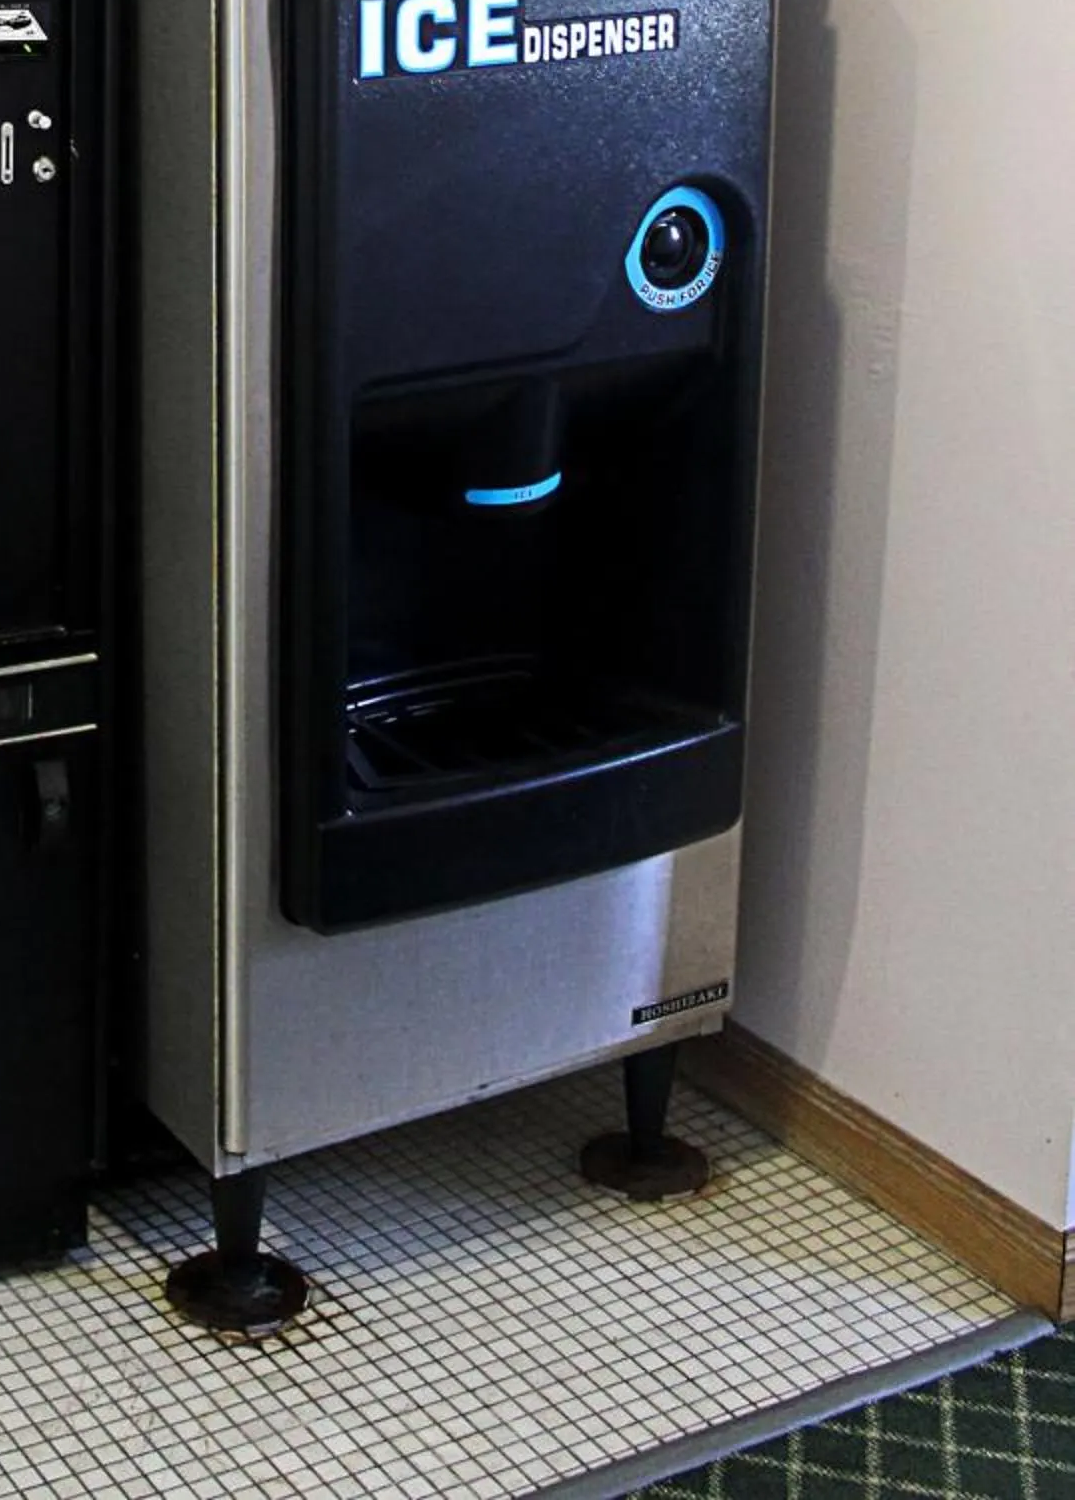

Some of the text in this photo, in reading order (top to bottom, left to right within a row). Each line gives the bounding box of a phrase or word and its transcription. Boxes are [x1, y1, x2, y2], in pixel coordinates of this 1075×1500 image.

[524, 13, 675, 63] DISPENSER
[640, 283, 675, 306] PUSH
[680, 279, 706, 302] FOR
